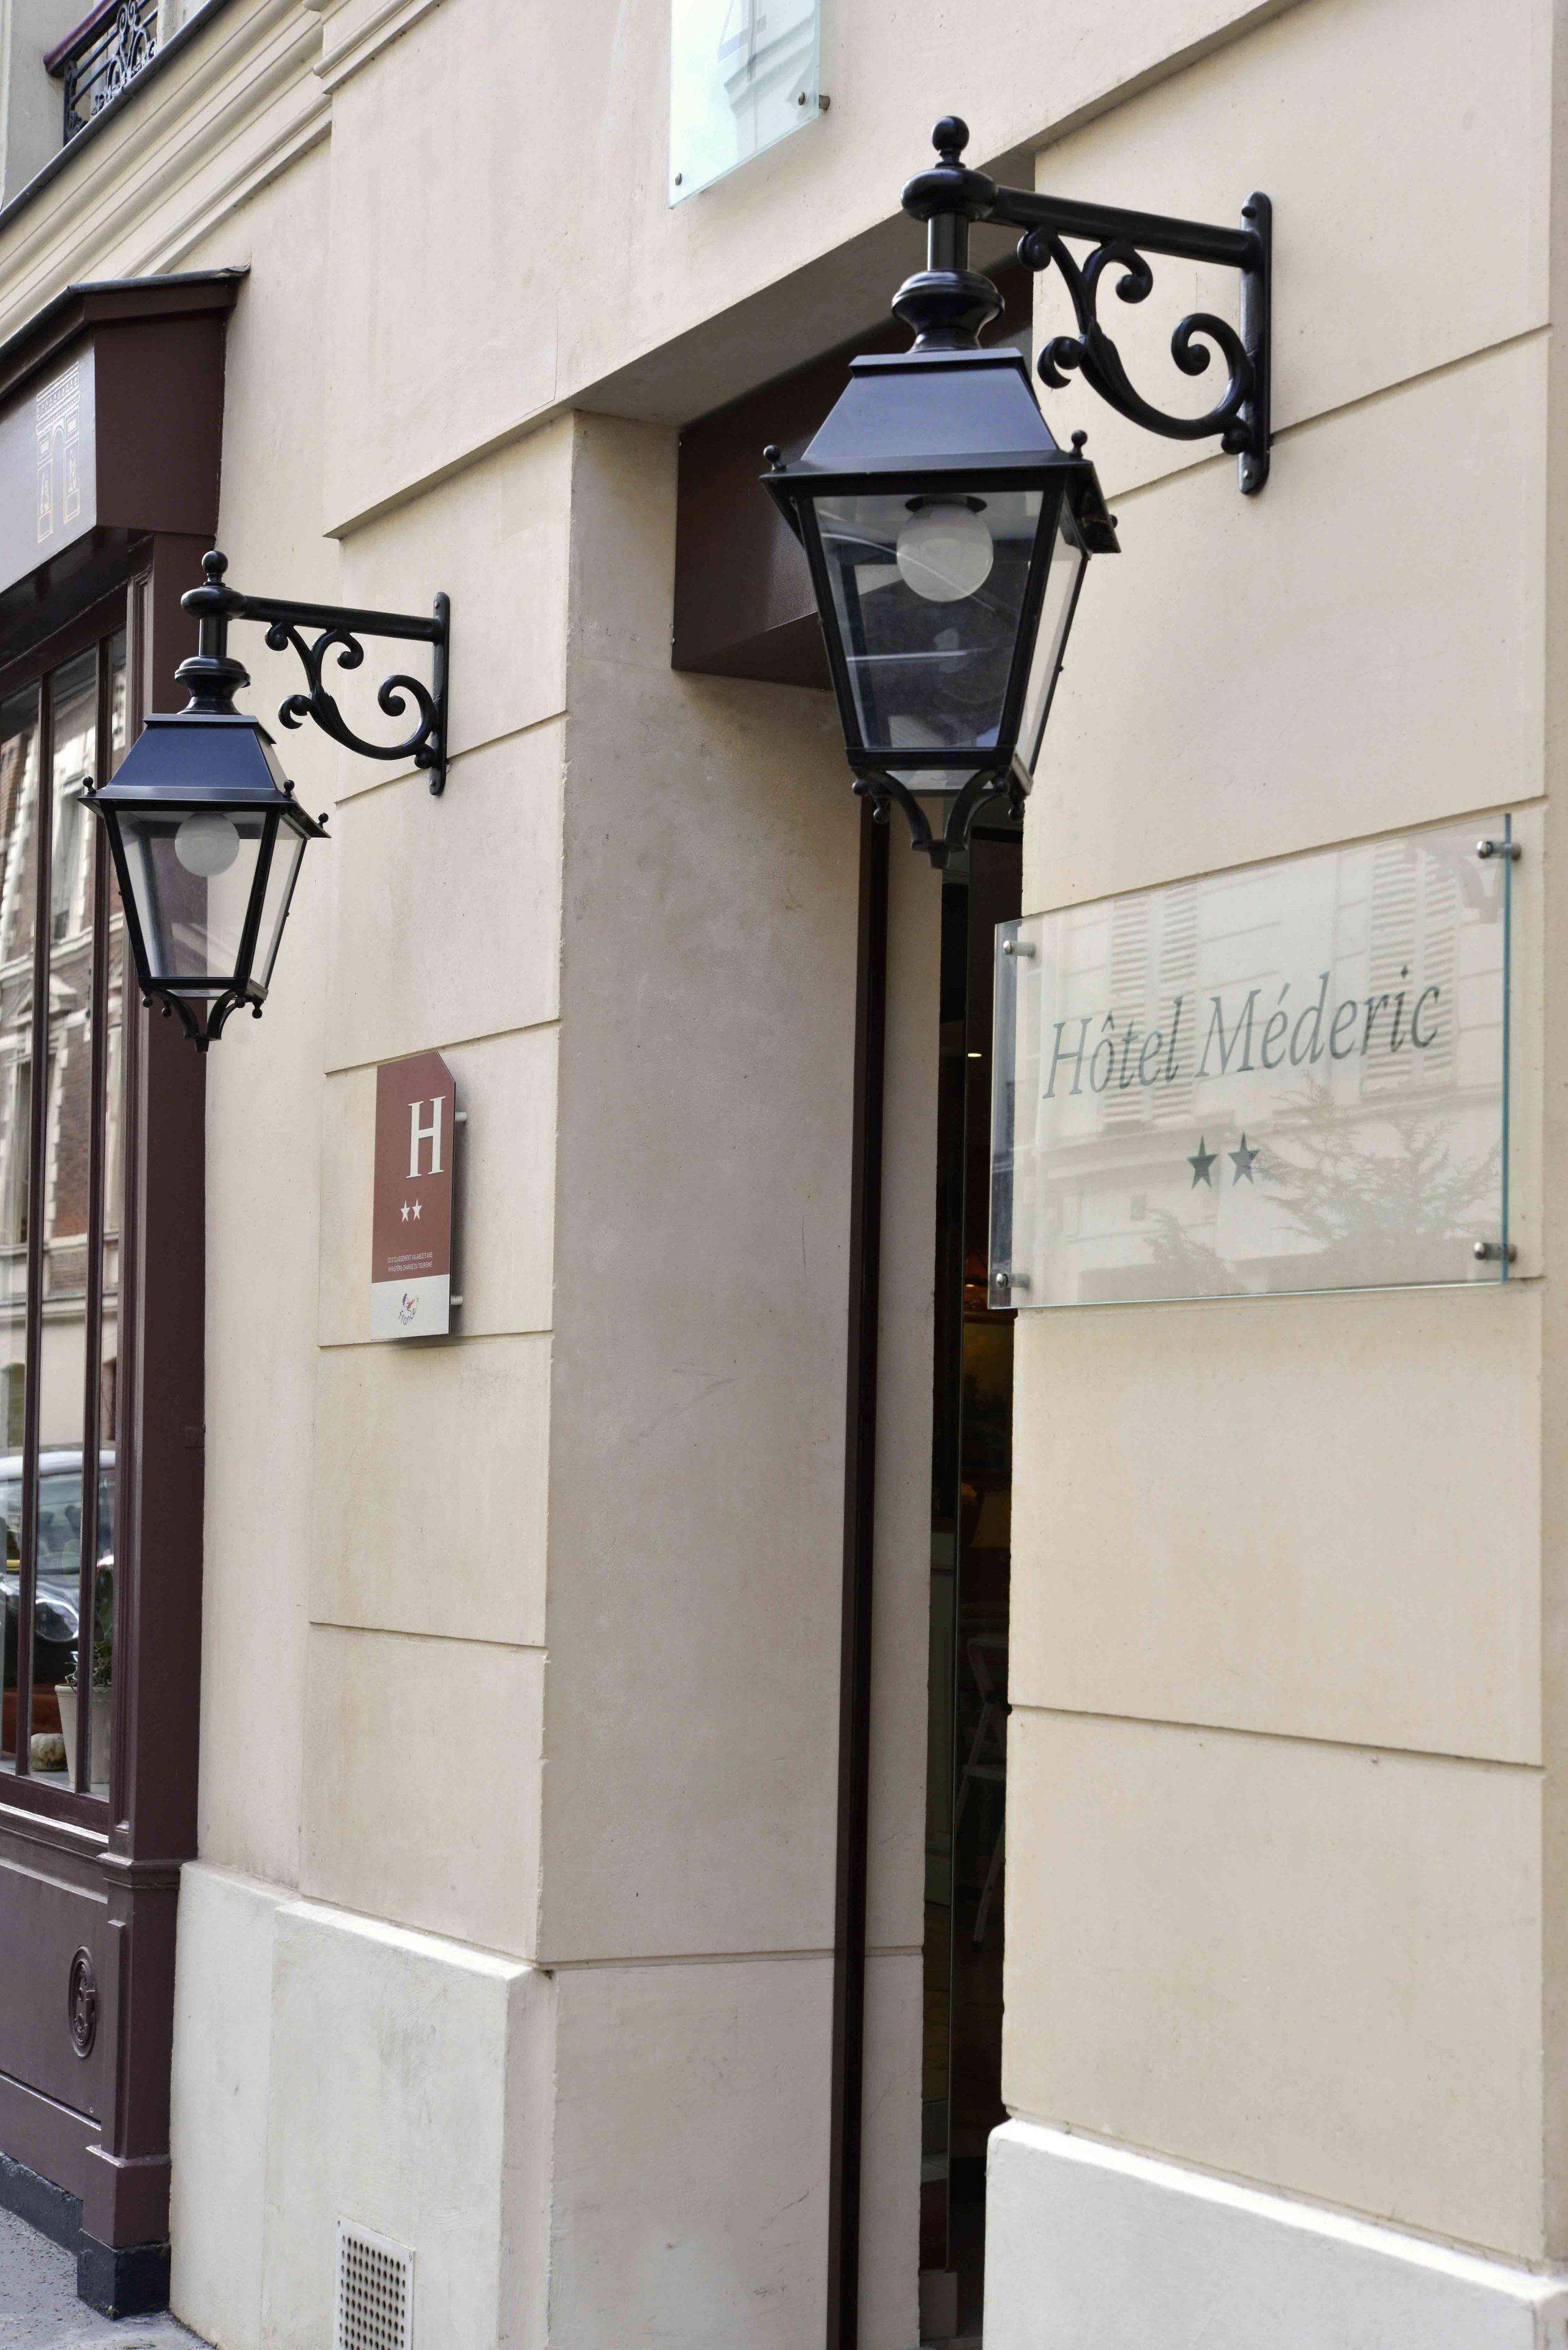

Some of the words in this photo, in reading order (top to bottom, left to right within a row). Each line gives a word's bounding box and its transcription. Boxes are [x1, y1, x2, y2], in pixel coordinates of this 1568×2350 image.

[1042, 996, 1183, 1099] Hôtel
[1195, 964, 1440, 1078] Méderic
[406, 1096, 446, 1179] H
